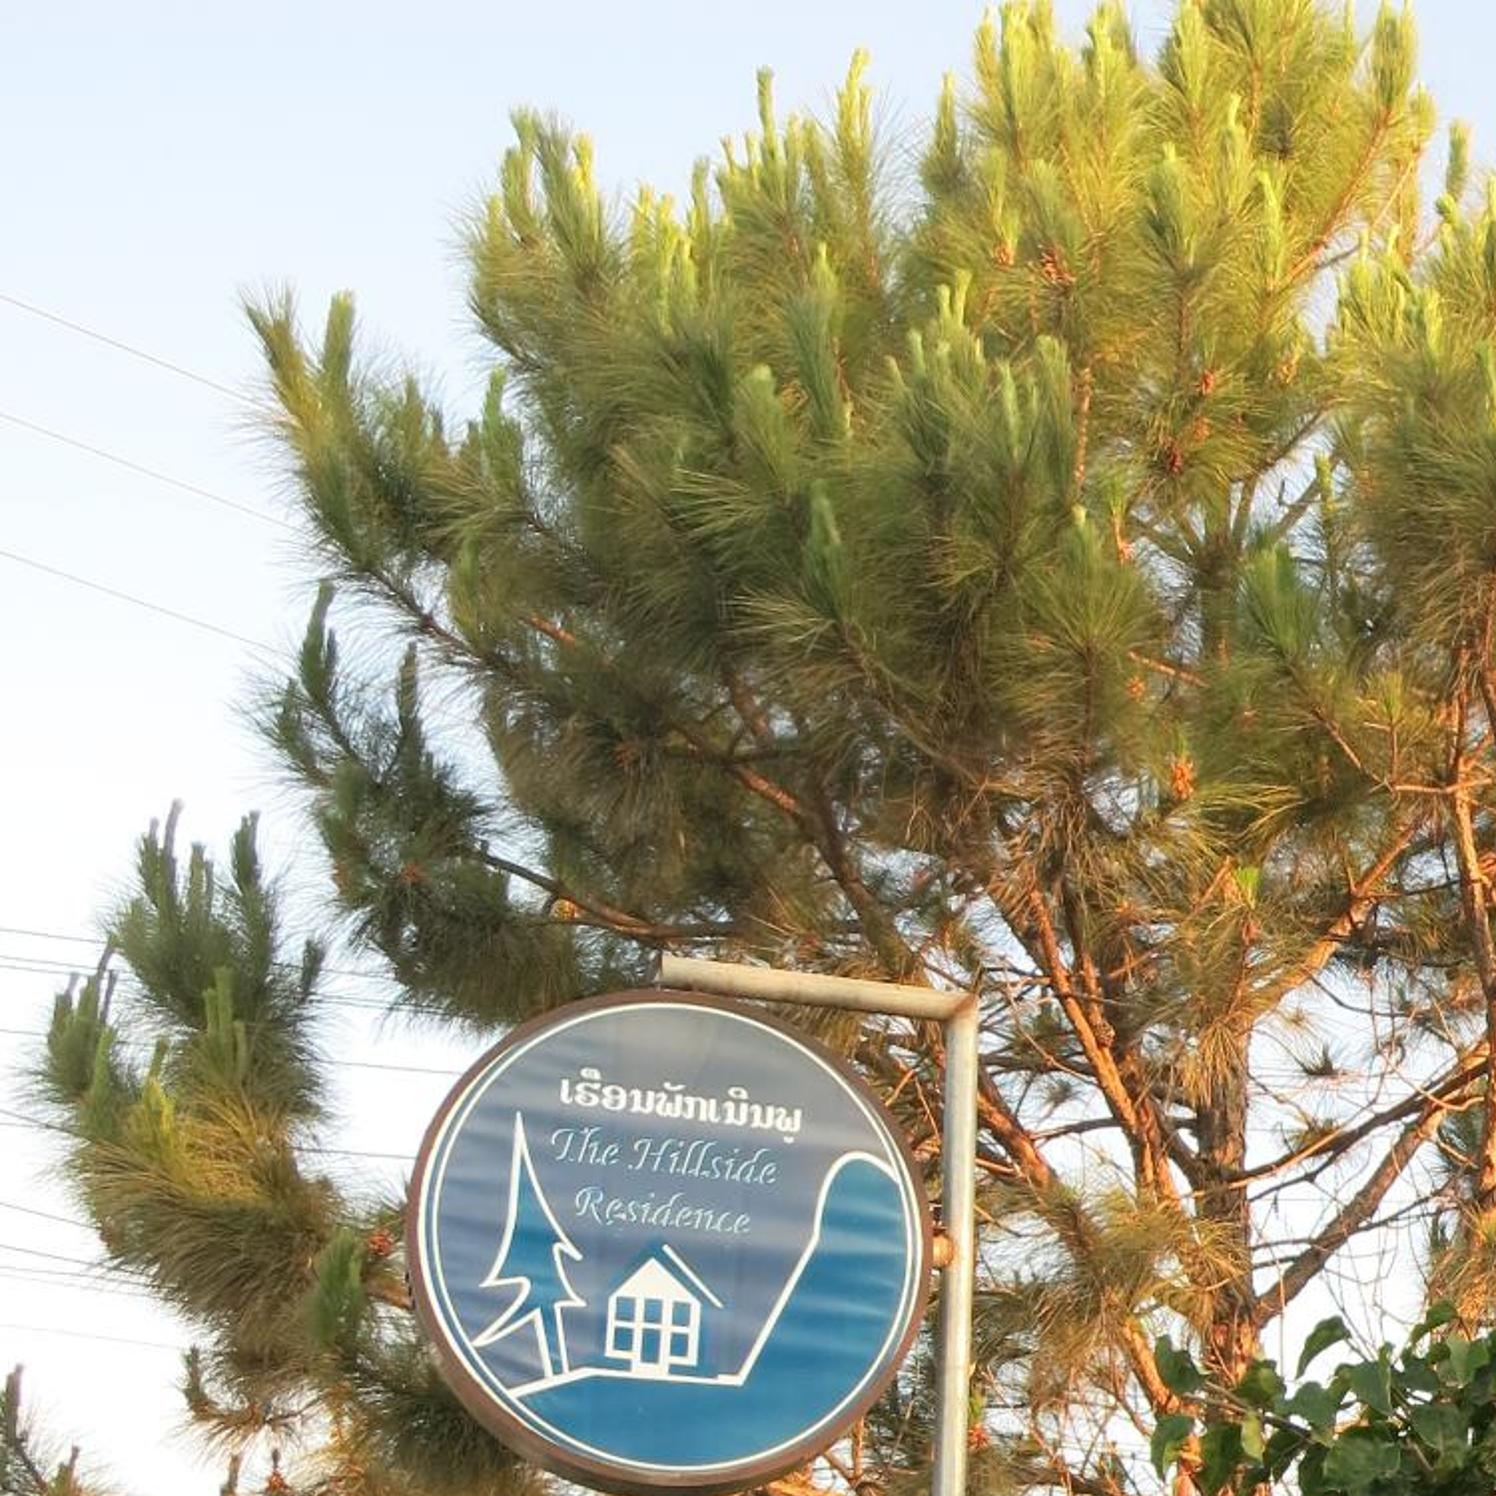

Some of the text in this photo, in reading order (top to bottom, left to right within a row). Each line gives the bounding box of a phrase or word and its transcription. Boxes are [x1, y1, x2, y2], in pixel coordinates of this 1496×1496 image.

[550, 1126, 778, 1185] The Hillside
[574, 1186, 751, 1234] Residence
